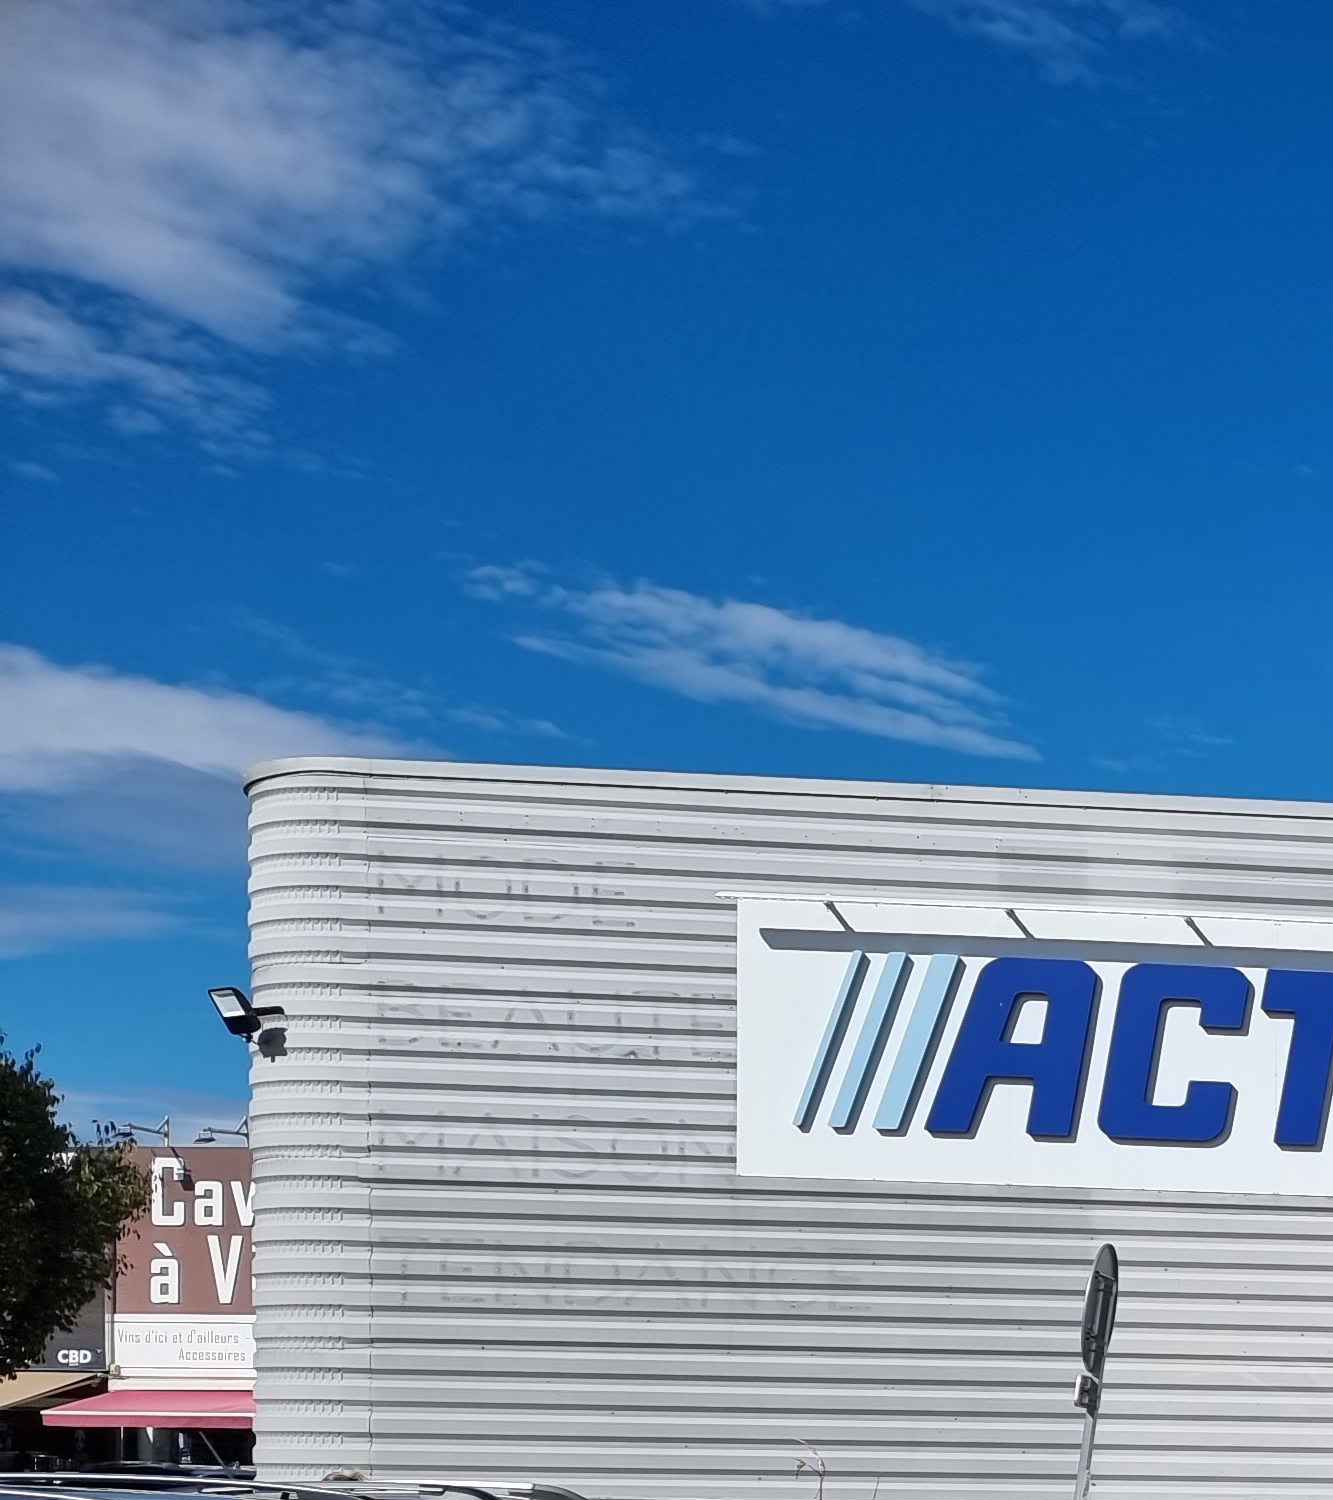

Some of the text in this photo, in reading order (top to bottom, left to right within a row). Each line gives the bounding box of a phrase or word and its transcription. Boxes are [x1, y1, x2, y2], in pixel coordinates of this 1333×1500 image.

[150, 1234, 257, 1305] à V
[117, 1329, 141, 1344] Vins
[144, 1328, 169, 1344] d'ici
[172, 1330, 184, 1344] et
[187, 1328, 239, 1344] d'ailleurs
[57, 1350, 92, 1364] CBD
[178, 1347, 246, 1362] Accessoires
